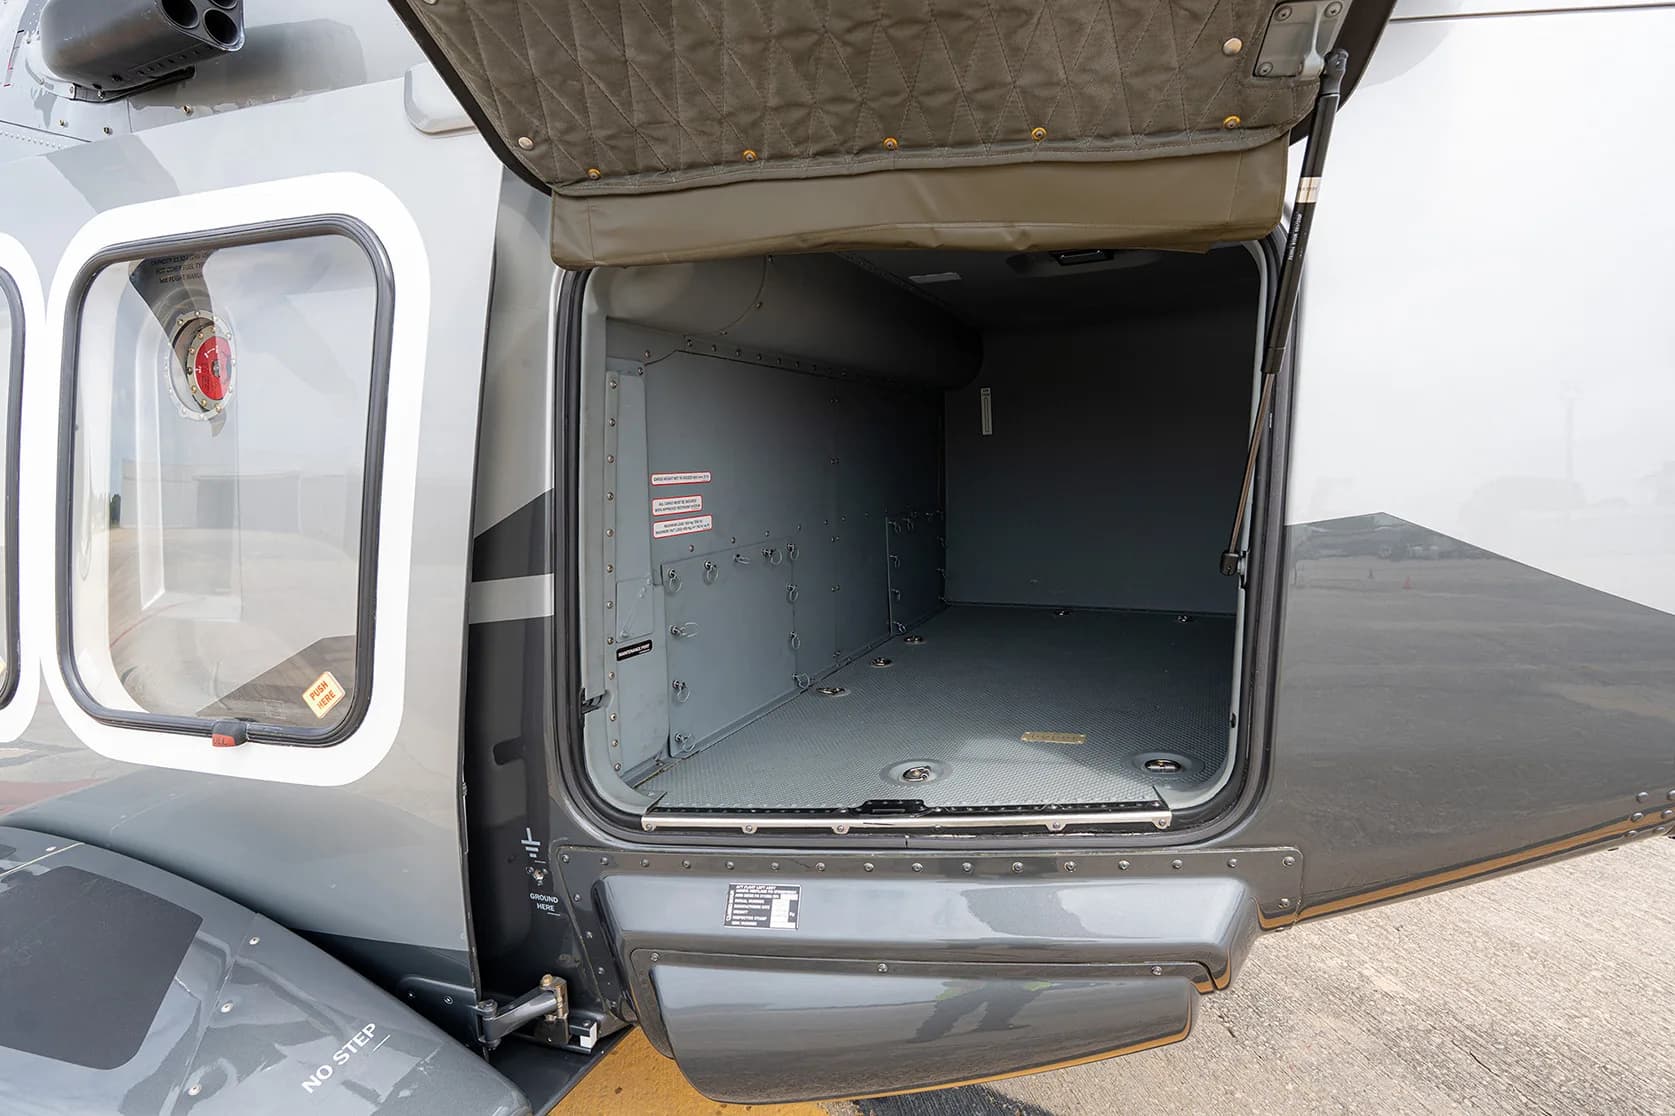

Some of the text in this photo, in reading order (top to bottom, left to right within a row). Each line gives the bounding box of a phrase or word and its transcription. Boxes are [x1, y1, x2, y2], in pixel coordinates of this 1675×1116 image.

[309, 680, 329, 701] PUSH
[316, 689, 336, 709] HERE
[530, 892, 559, 904] GROUND
[536, 902, 556, 912] HERE
[301, 1023, 376, 1094] NO STEP
